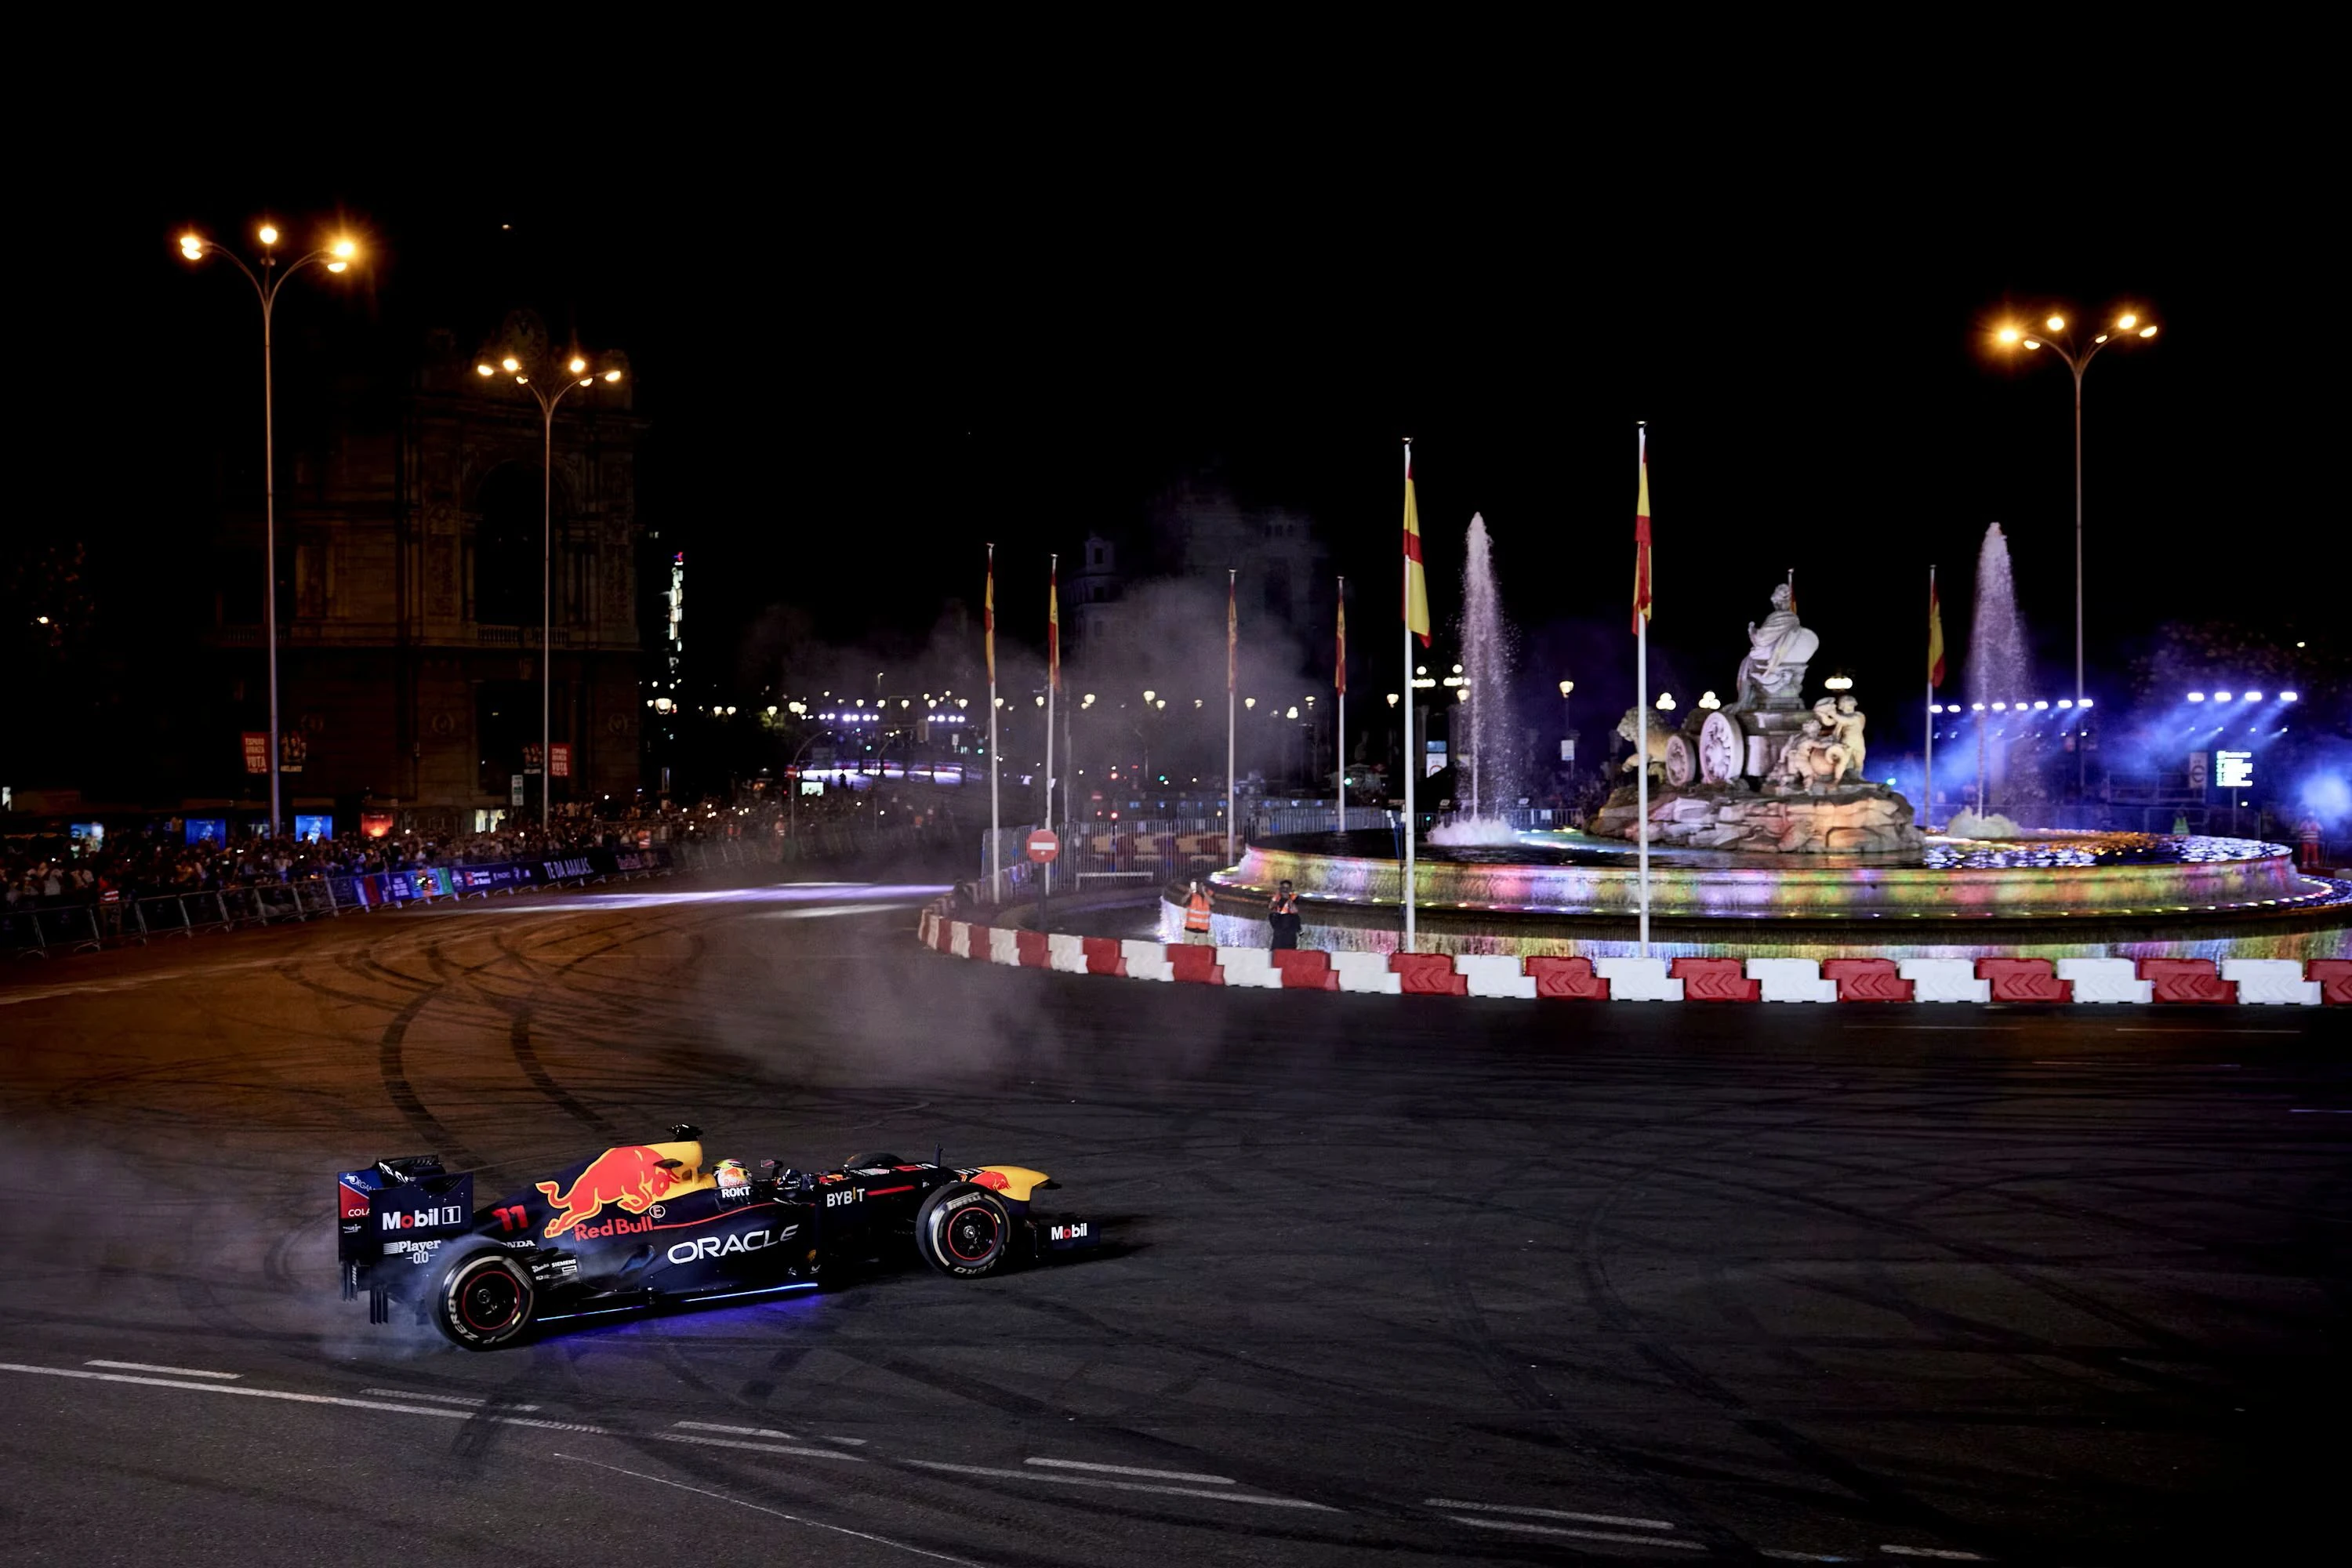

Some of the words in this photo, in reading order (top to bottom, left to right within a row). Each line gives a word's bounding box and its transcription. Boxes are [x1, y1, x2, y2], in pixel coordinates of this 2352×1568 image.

[721, 1185, 752, 1199] ROKT
[826, 1186, 866, 1207] BYBIT
[382, 1207, 439, 1231] Mobil
[492, 1204, 529, 1232] 11
[573, 1218, 614, 1243] Red
[615, 1215, 654, 1235] Bull
[1051, 1222, 1087, 1240] Mobil
[398, 1240, 442, 1254] Player
[666, 1223, 800, 1265] ORACLE
[551, 1258, 577, 1269] SIEMENS
[448, 1298, 479, 1341] ZERO
